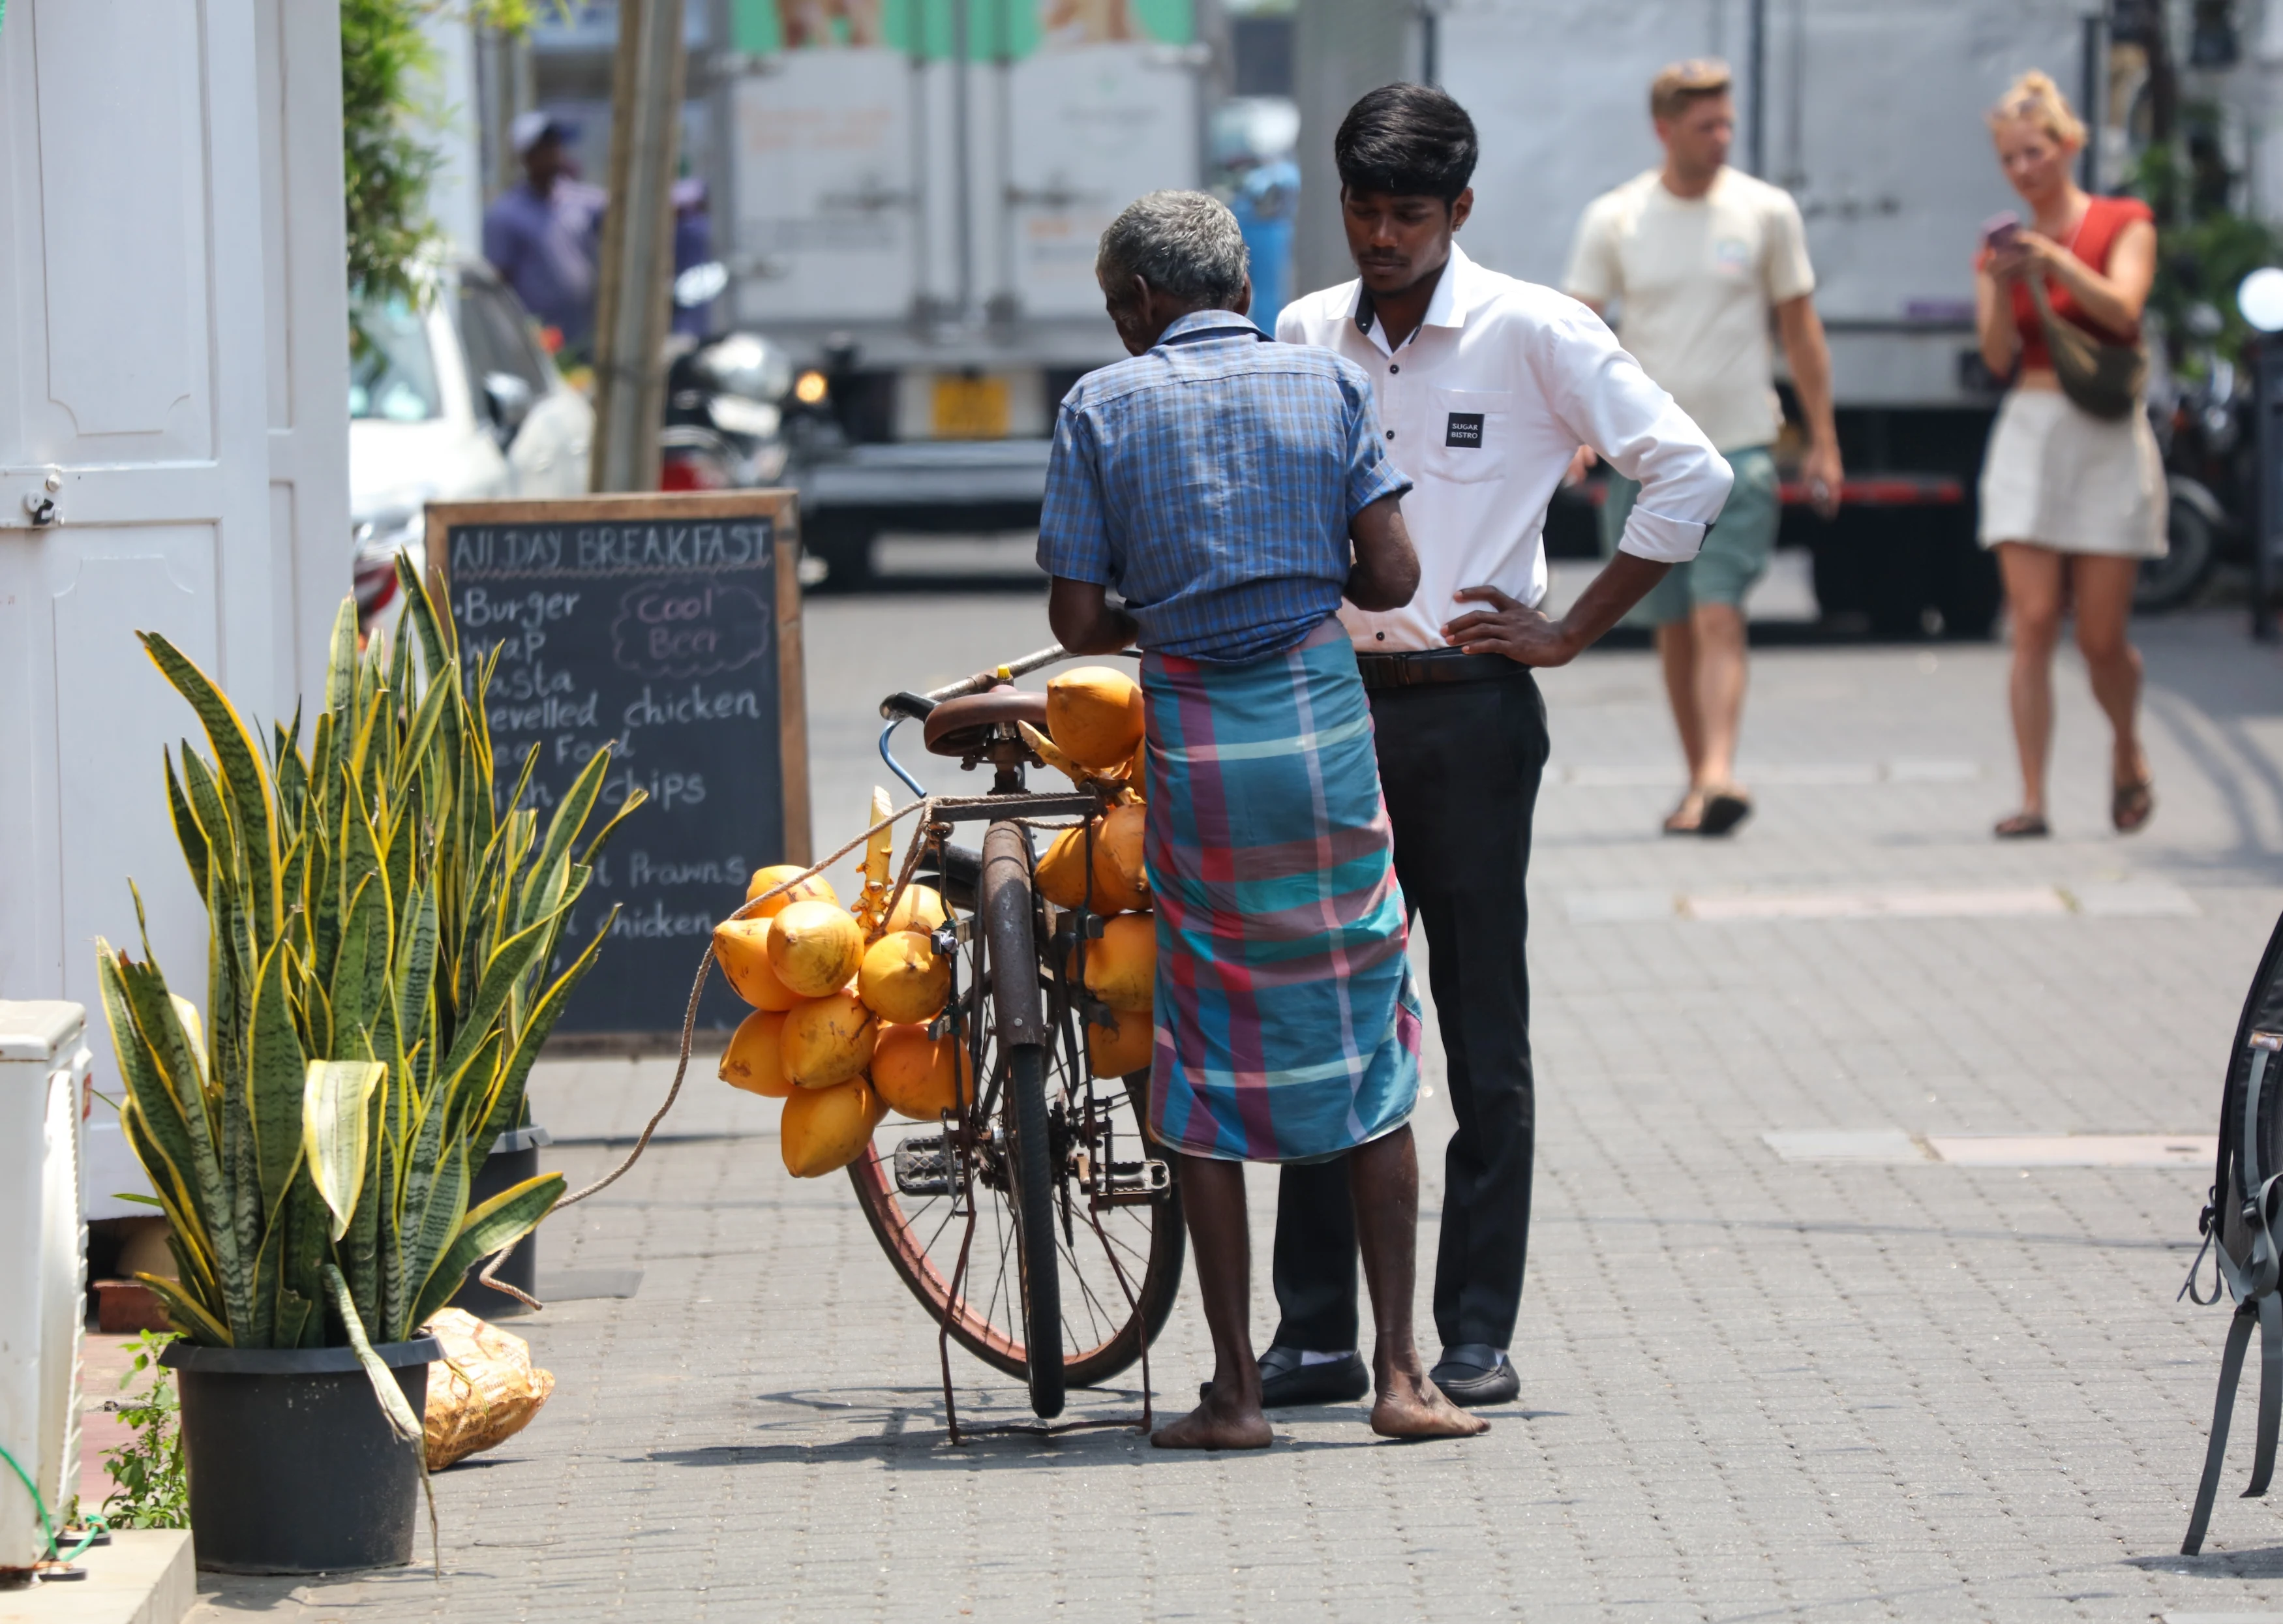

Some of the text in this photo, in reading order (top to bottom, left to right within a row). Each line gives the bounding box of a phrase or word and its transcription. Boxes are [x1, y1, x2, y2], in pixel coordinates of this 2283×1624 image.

[502, 530, 562, 568] DAY
[577, 524, 770, 569] BREAKFAST
[464, 586, 581, 629] Burger
[637, 587, 714, 624] Cool
[648, 625, 720, 661] Beer
[489, 682, 761, 731] evelled chicken
[555, 726, 637, 766] Fod
[628, 850, 749, 889] Prawns
